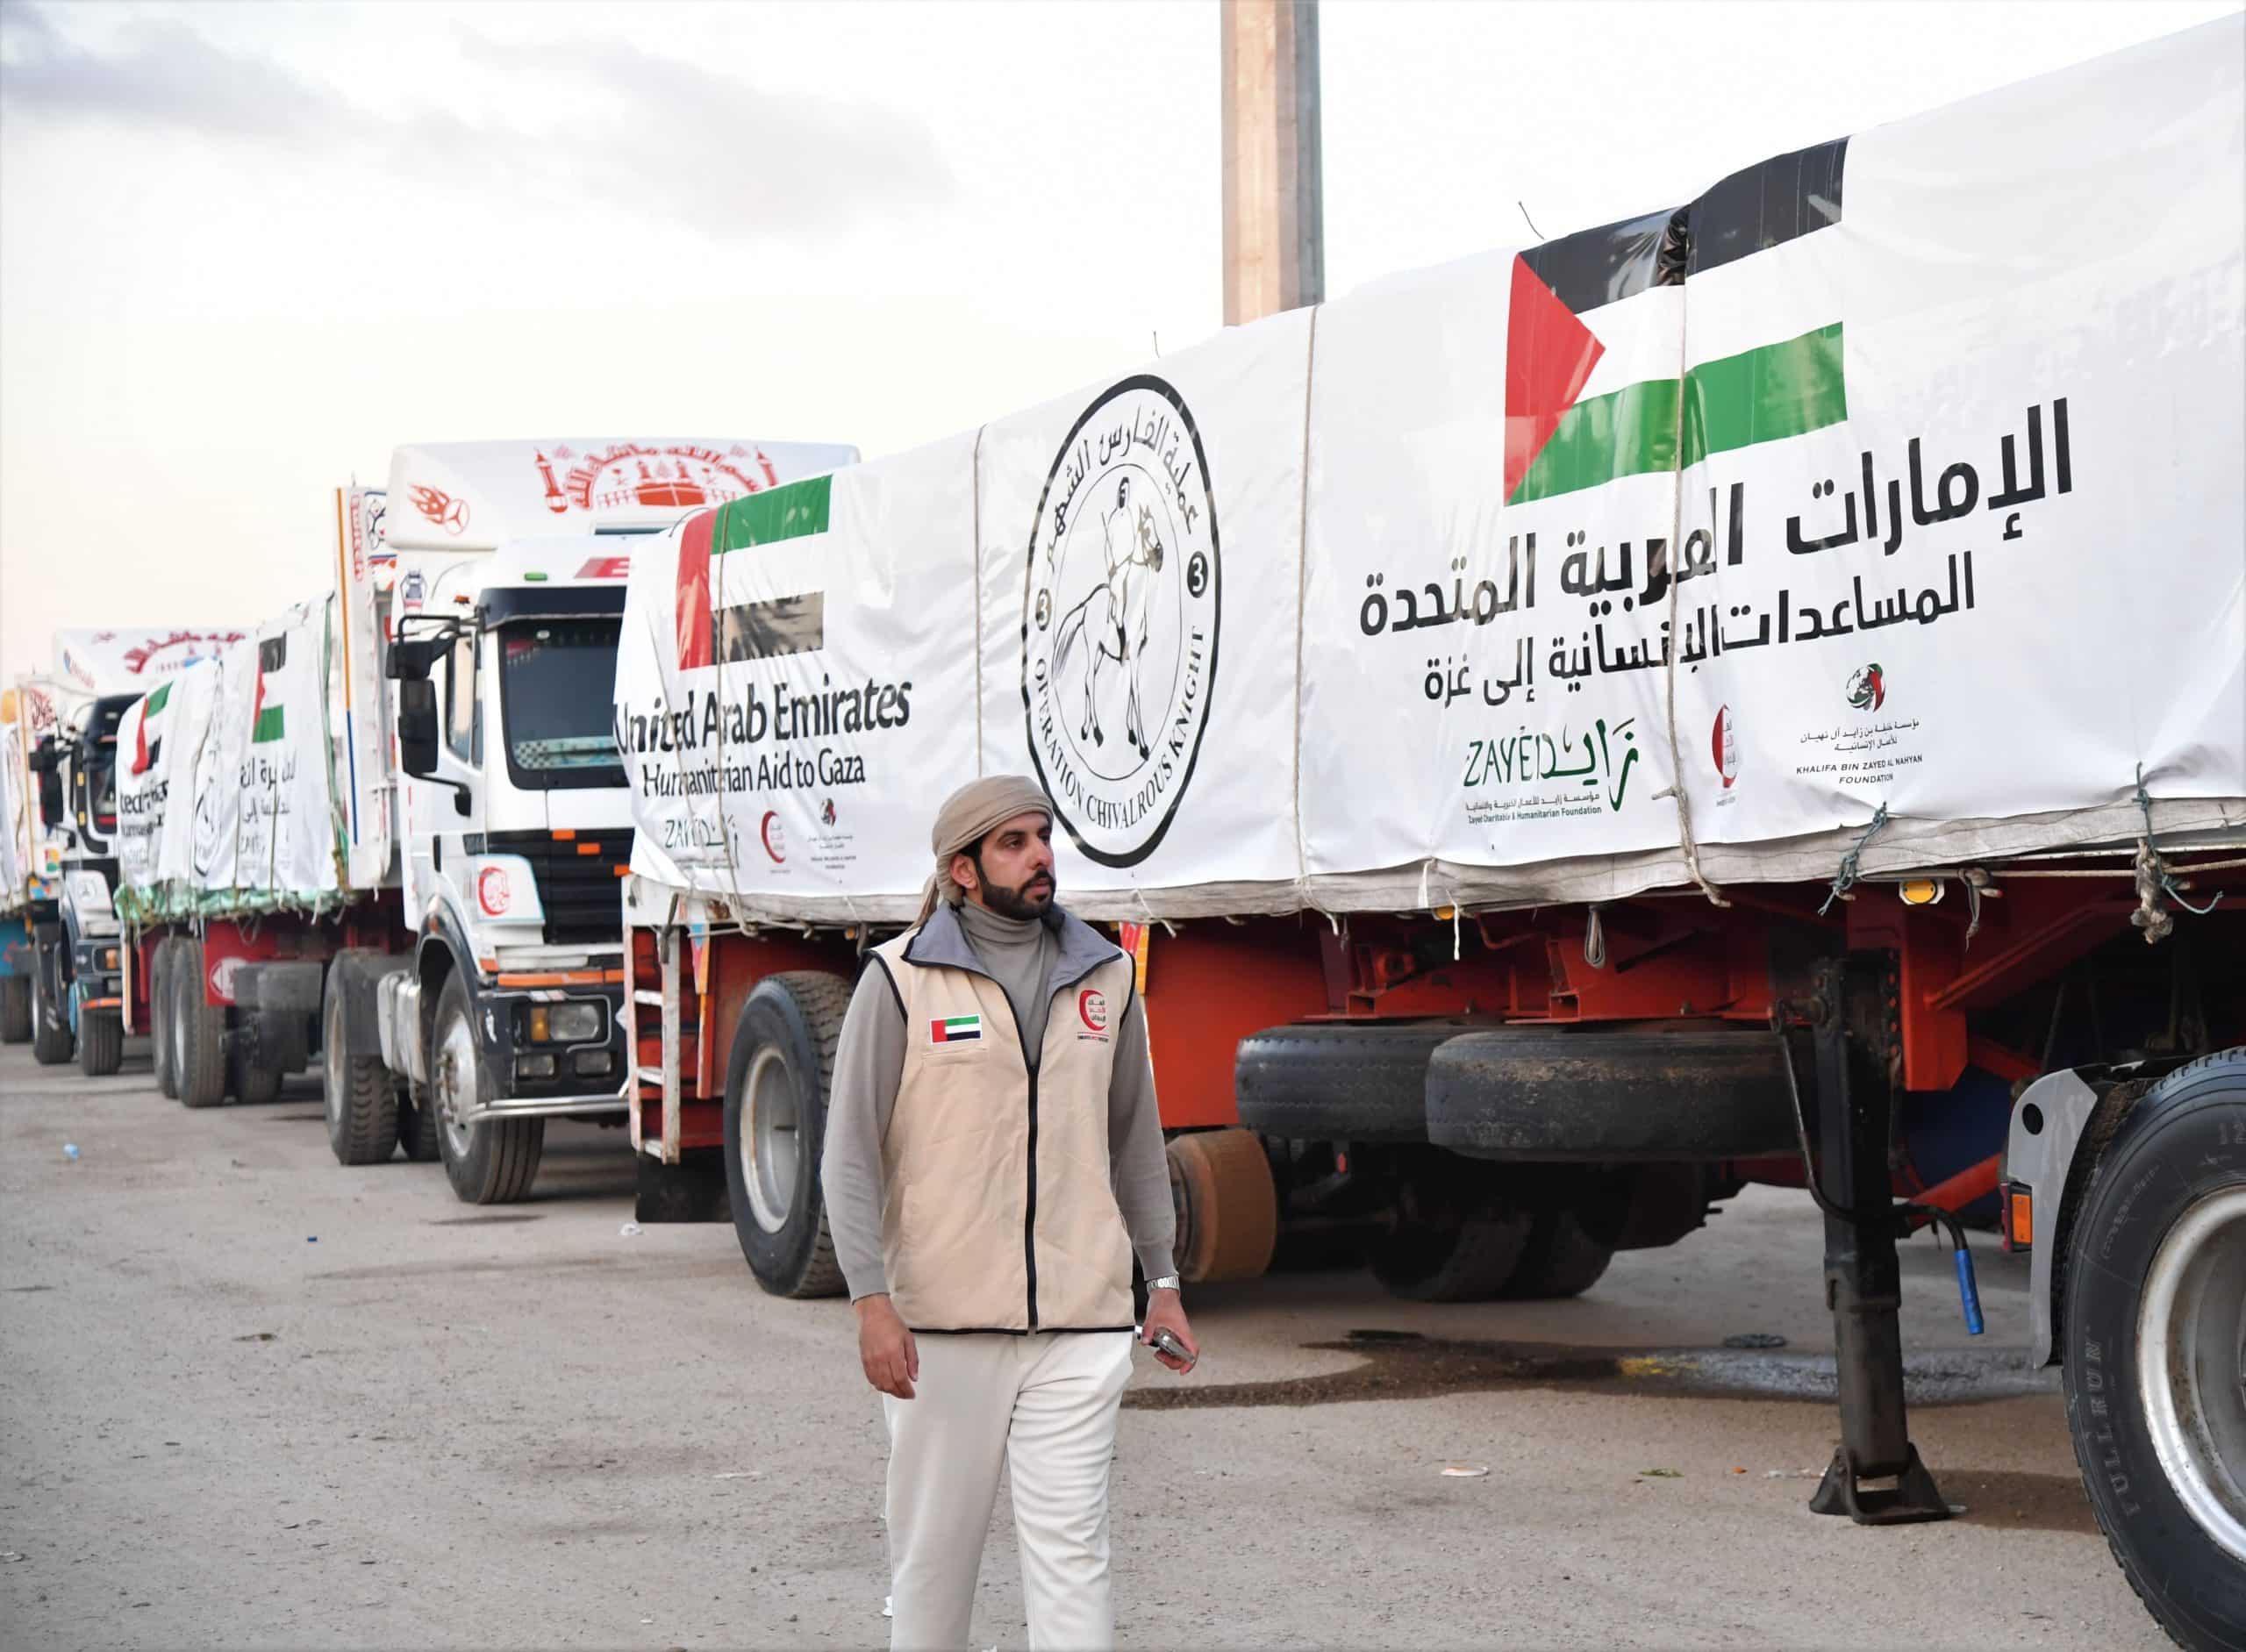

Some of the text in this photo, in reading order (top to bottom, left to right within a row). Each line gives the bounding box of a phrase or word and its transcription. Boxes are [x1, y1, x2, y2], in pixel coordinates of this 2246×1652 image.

[1099, 404, 1169, 466] الفارس
[1360, 397, 2072, 636] الإمارات العربية المتحدة
[1720, 550, 1976, 652] المساعدات
[1424, 652, 1471, 710] غزة
[1483, 637, 1534, 707] إلى
[702, 682, 768, 747] Arab
[773, 673, 913, 740] Emirates
[1034, 625, 1205, 830] OPERATION CHIVALROUS KNIGHT
[757, 750, 792, 790] Aid
[795, 758, 815, 789] to
[818, 747, 866, 786] Gaza
[1463, 726, 1556, 787] ZAYED
[1796, 763, 1838, 775] KHALIFA
[1841, 762, 1860, 772] BIN
[1863, 760, 1886, 770] ZAYED
[1895, 754, 1923, 766] NAHYAN
[1839, 772, 1893, 784] FOUNDATION
[1517, 808, 1560, 820] Humanitarian
[1561, 805, 1603, 818] Foundation
